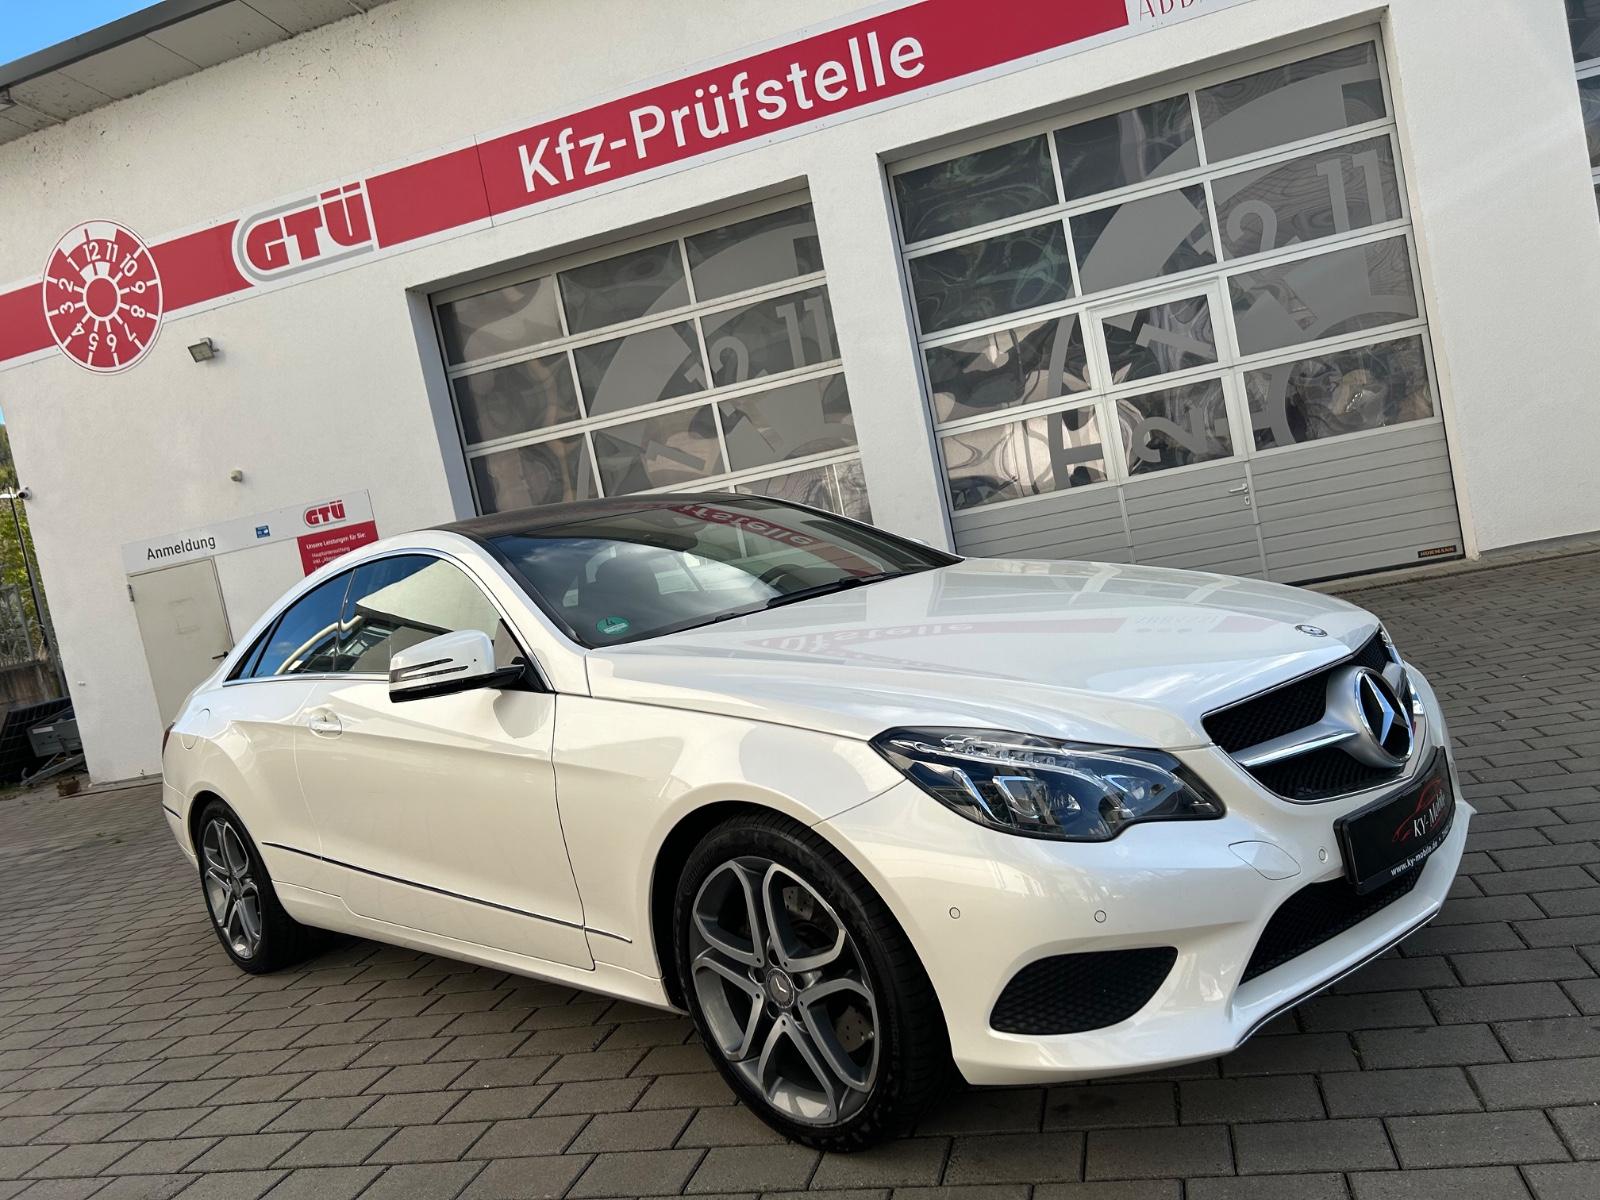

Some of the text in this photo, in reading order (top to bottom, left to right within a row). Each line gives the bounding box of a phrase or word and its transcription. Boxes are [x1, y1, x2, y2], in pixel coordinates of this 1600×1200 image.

[518, 31, 926, 193] Kfz-Prüfstelle
[246, 181, 372, 271] GTÜ
[83, 242, 101, 262] 12
[105, 242, 119, 262] 11
[67, 256, 80, 272] 1
[119, 253, 138, 277] 10
[58, 278, 74, 293] 2
[129, 281, 146, 294] 9
[59, 301, 75, 314] 3
[130, 305, 146, 318] 8
[71, 322, 86, 336] 4
[123, 322, 137, 342] 7
[88, 333, 100, 352] 5
[106, 334, 117, 352] 6
[304, 499, 346, 526] GTÜ
[147, 537, 217, 561] Anmeldung
